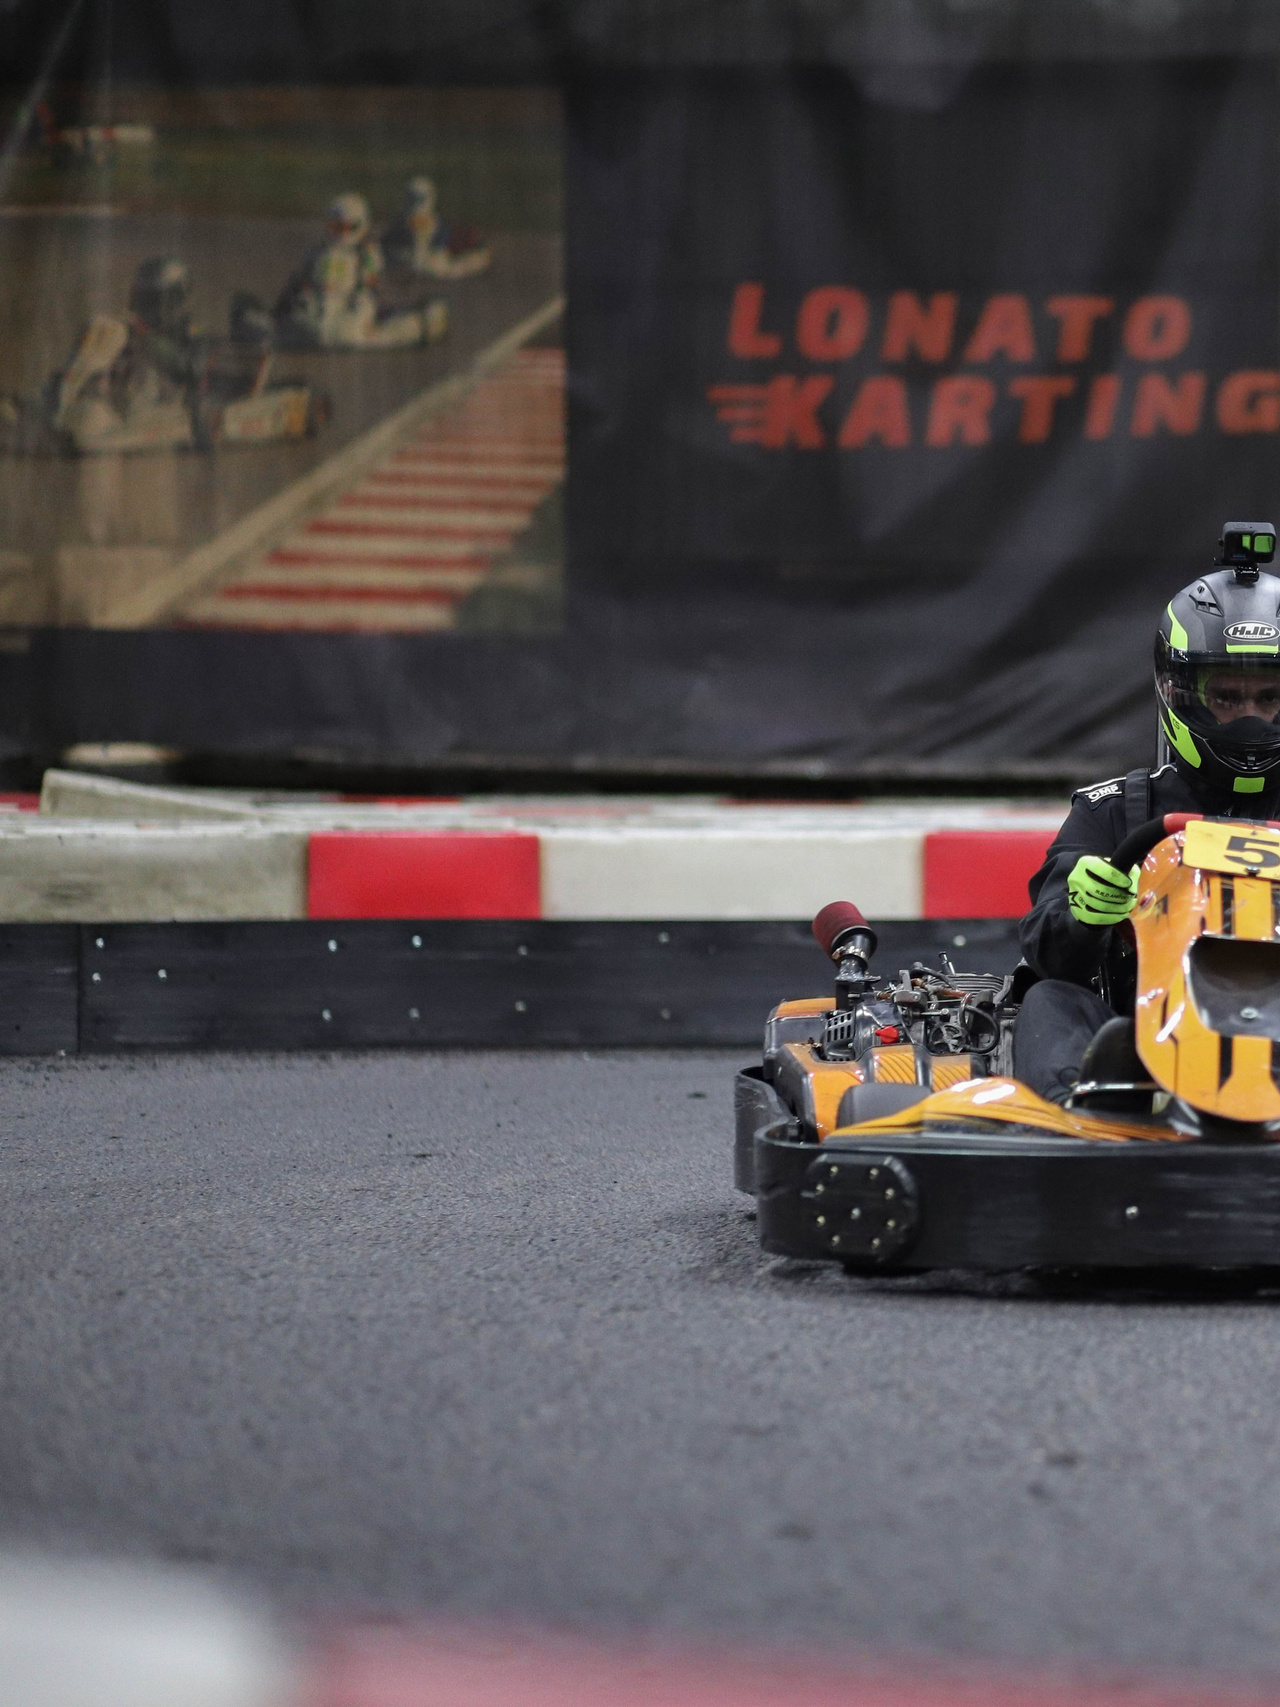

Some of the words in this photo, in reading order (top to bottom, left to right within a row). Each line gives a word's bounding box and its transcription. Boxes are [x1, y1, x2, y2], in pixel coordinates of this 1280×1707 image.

[729, 283, 1190, 361] LONATO
[1231, 626, 1273, 636] HJC
[1085, 783, 1120, 801] OMP
